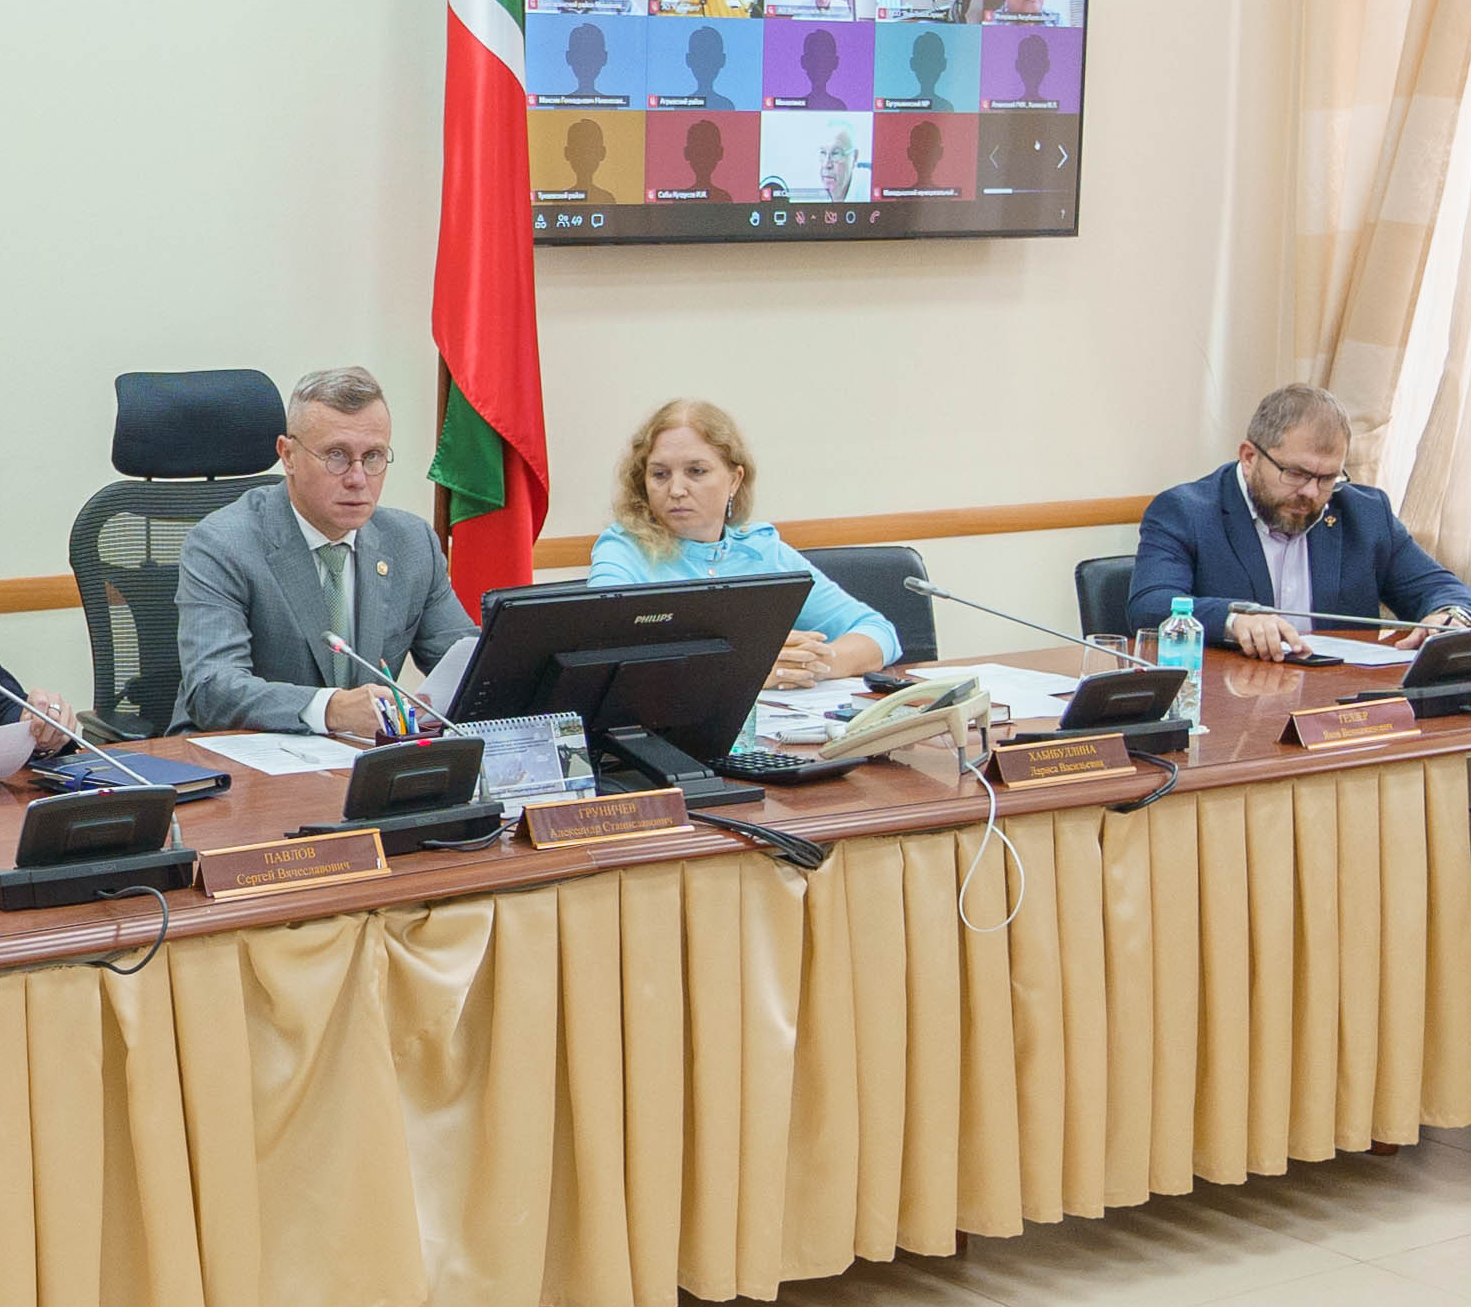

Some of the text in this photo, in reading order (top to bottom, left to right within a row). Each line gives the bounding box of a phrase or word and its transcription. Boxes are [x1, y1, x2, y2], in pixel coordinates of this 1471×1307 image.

[634, 613, 674, 624] PHILIPS
[264, 847, 316, 865] ПАВЛОВ
[236, 861, 351, 887] Сергей Вячеславович
